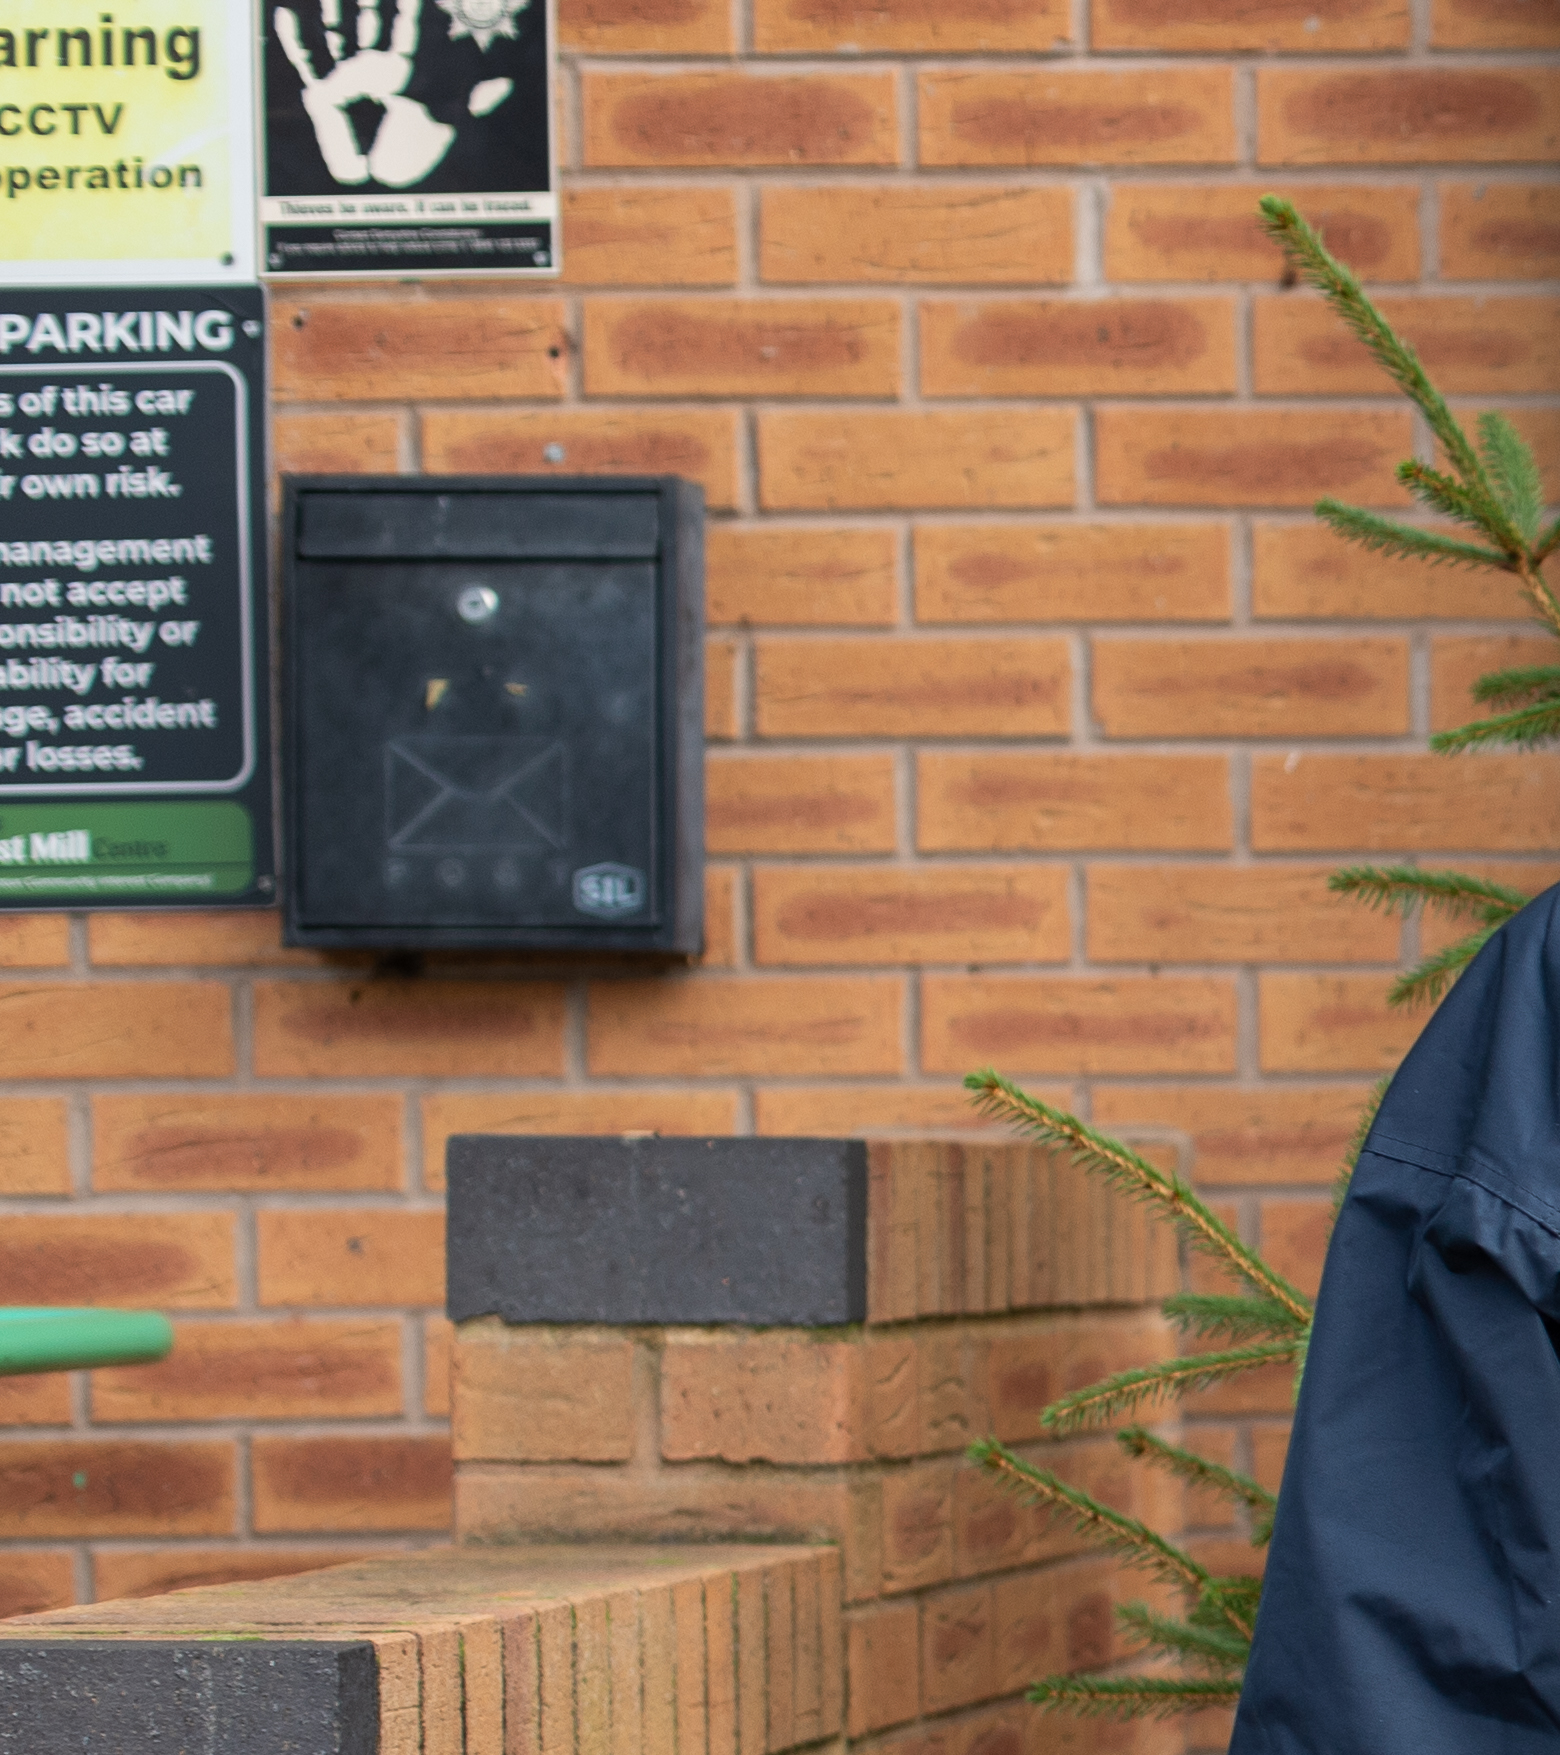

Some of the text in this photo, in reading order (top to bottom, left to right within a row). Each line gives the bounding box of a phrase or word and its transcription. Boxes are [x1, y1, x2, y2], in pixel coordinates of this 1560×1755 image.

[0, 102, 124, 136] CCTV
[0, 156, 203, 199] peration
[0, 310, 236, 353] PARKING
[18, 386, 60, 416] of
[62, 383, 132, 416] this
[135, 388, 194, 415] car
[27, 427, 78, 457] do
[80, 431, 126, 457] so
[129, 427, 170, 456] at
[20, 473, 101, 499] own
[104, 465, 183, 498] risk.
[0, 535, 213, 571] anagement
[66, 576, 188, 611] accept
[158, 620, 199, 646] or
[101, 656, 156, 688] for
[63, 696, 217, 730] accident
[25, 740, 143, 772] losses.
[29, 829, 91, 864] Mill
